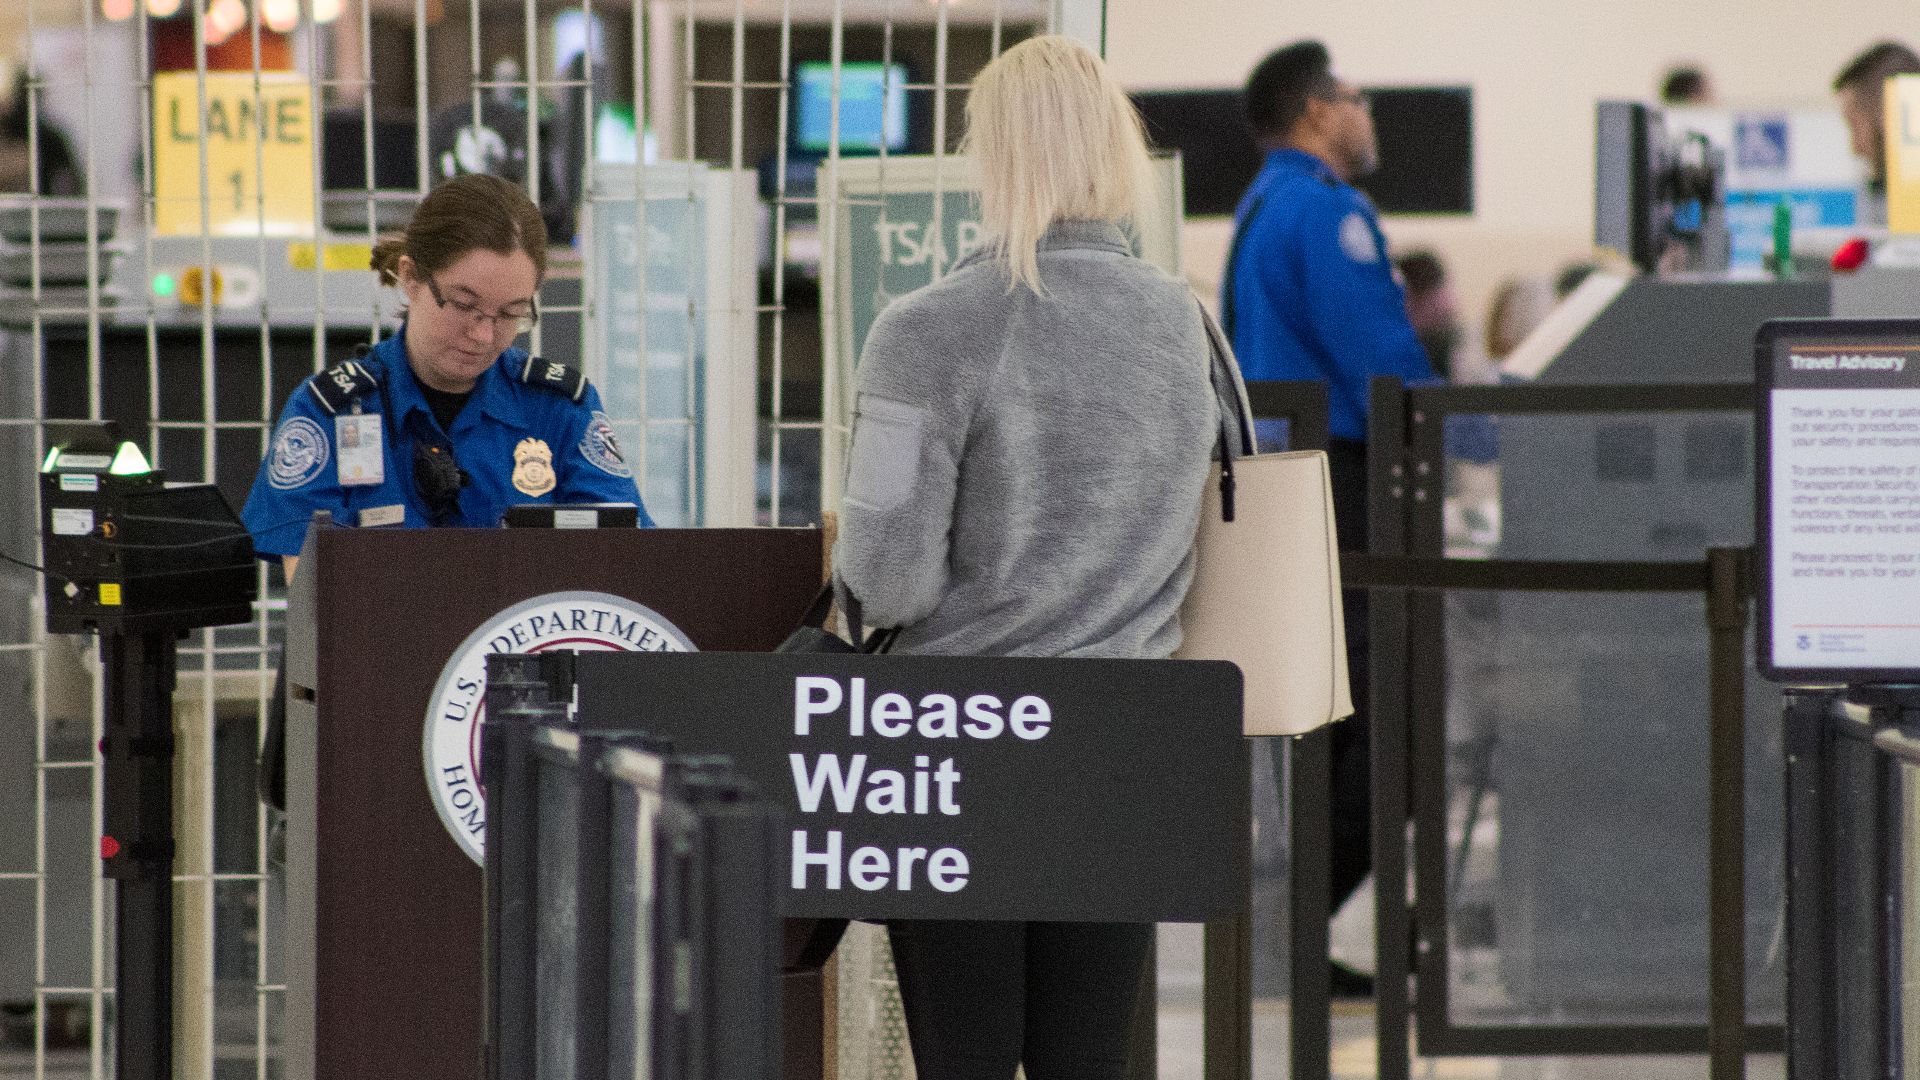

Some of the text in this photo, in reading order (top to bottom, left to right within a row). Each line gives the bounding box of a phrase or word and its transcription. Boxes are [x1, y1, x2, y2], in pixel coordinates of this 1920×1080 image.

[170, 98, 304, 144] LANE
[228, 170, 244, 213] 1
[873, 222, 949, 265] TSA
[545, 362, 566, 381] TSA
[1790, 354, 1906, 372] Travel Advisory
[328, 365, 356, 394] TSA
[1791, 407, 1824, 417] Thank
[1829, 408, 1848, 419] you
[1850, 407, 1866, 417] for
[1870, 408, 1893, 419] your
[1791, 422, 1808, 432] out
[1812, 422, 1854, 434] security
[1791, 437, 1816, 448] your
[1820, 436, 1851, 448] safety
[1856, 436, 1877, 446] and
[1791, 464, 1917, 477] To protect the safety of
[1791, 480, 1872, 492] Transportation
[1791, 495, 1819, 504] other
[1823, 495, 1883, 504] individuals
[1791, 524, 1837, 533] violence
[1840, 523, 1851, 533] of
[1854, 524, 1873, 535] any
[1877, 523, 1902, 533] kind
[1791, 552, 1915, 564] Please proceed to your
[1792, 567, 1916, 580] and thank you for your
[445, 677, 484, 723] U.S.
[793, 676, 1052, 740] Please
[788, 753, 961, 816] Wait
[790, 830, 970, 893] Here
